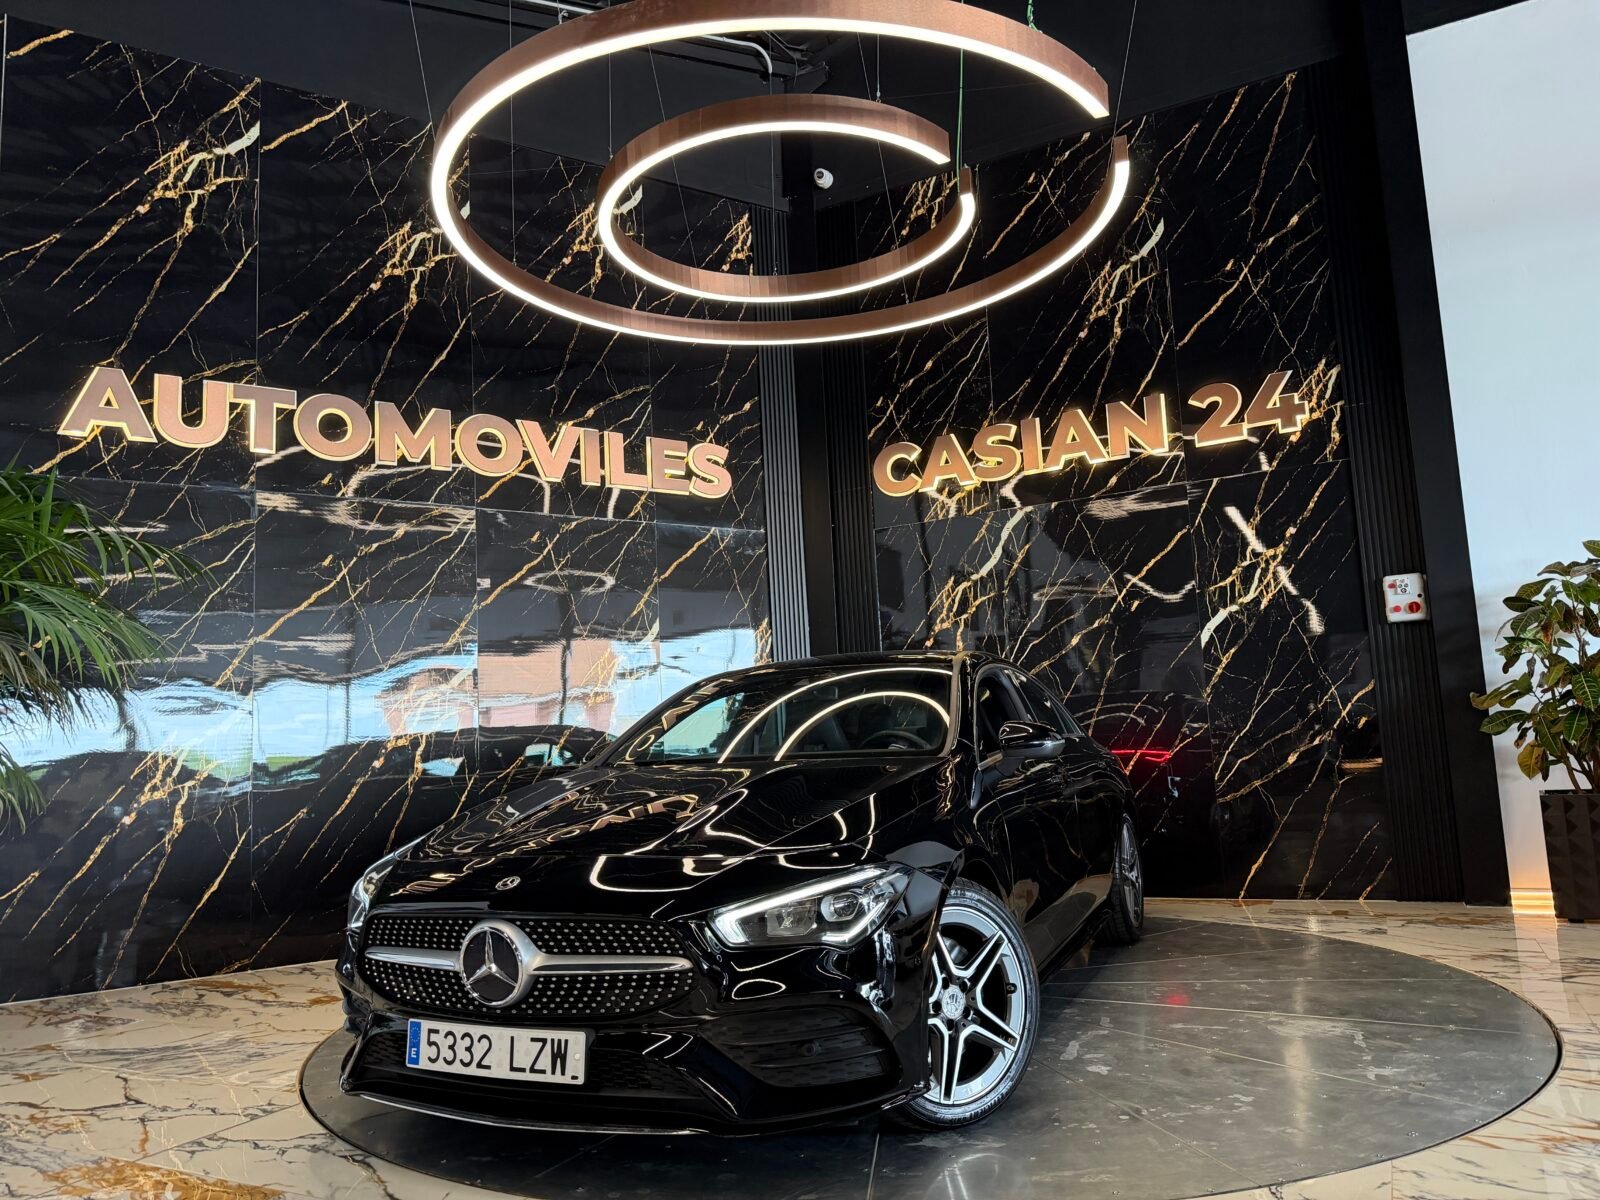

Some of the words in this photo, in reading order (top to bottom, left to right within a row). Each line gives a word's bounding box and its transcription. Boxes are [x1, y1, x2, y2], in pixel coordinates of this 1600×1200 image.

[58, 366, 732, 498] AUTOMOVILES
[872, 393, 1170, 497] CASIAN
[1187, 369, 1309, 448] 24
[411, 1048, 417, 1058] E
[427, 1028, 493, 1070] 5332
[509, 1036, 569, 1076] LZW
